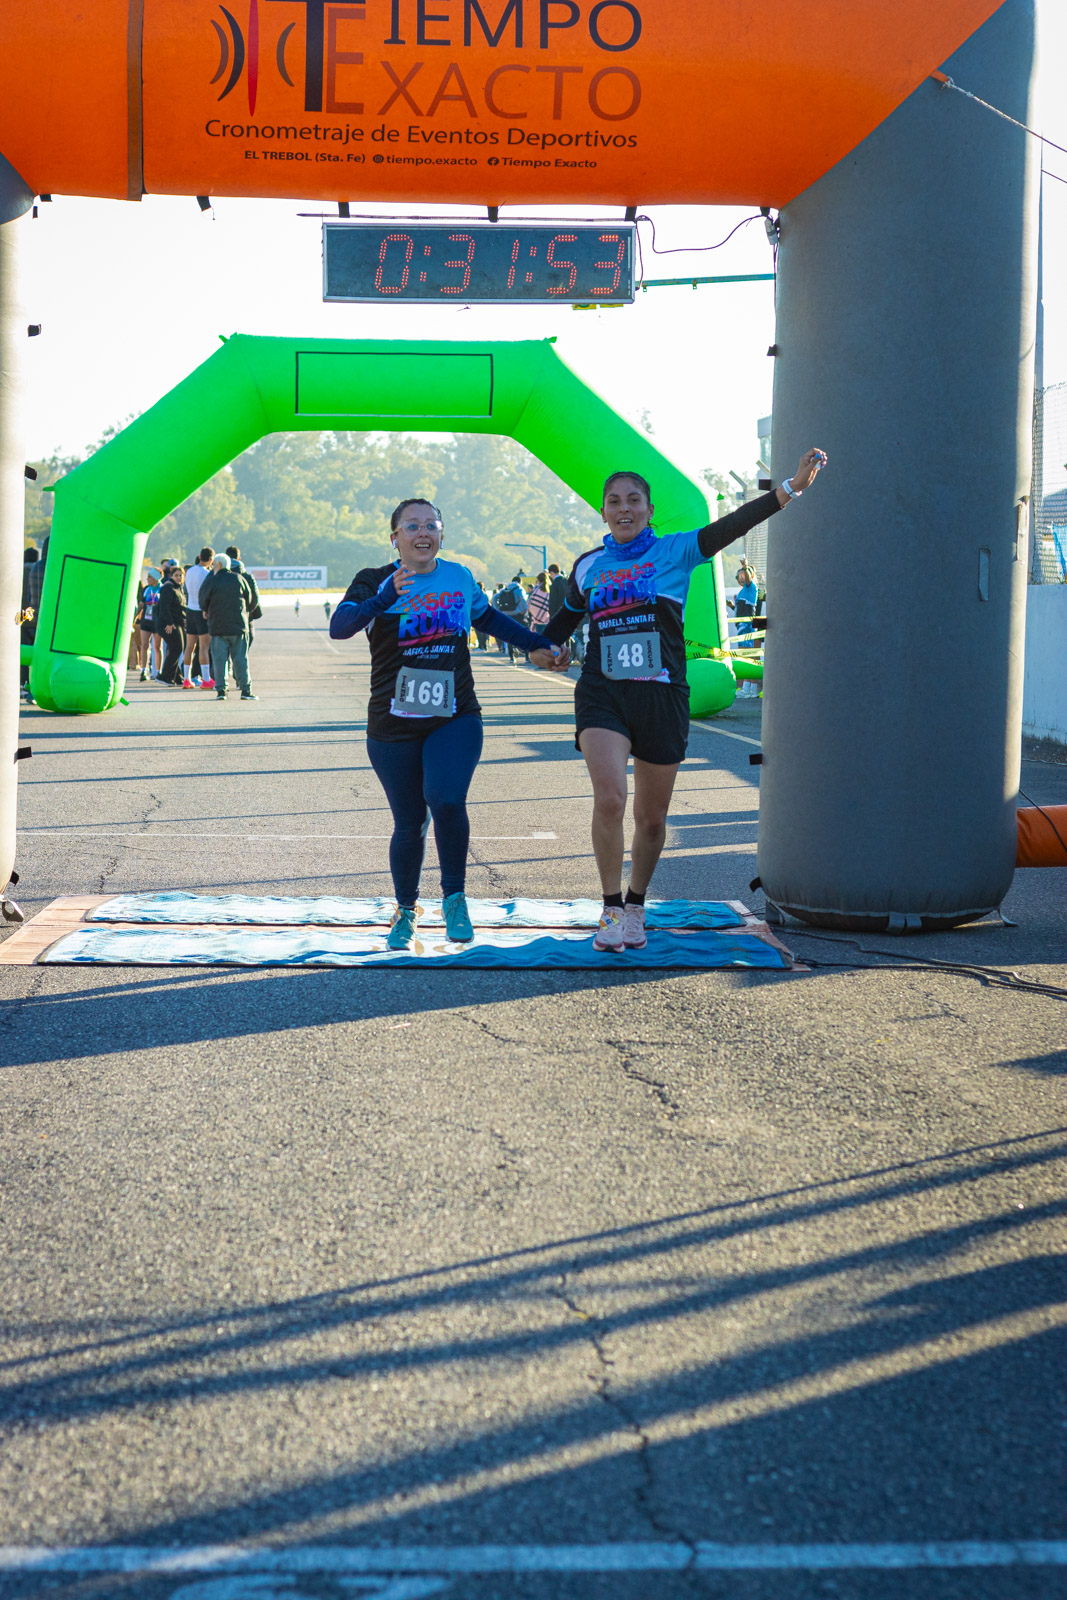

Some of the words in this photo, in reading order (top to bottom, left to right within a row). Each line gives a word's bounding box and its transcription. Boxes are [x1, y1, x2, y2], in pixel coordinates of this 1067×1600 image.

[205, 119, 364, 145] Cronometraje
[371, 124, 400, 142] de
[408, 126, 499, 145] Eventos
[507, 128, 637, 150] Deportivos
[244, 150, 259, 160] EL
[262, 151, 312, 161] TREBOL
[315, 153, 344, 163] (Sta.
[347, 153, 366, 163] Fe)
[386, 155, 477, 166] tiempo.exacto
[502, 157, 551, 169] Tiempo
[554, 159, 598, 168] Exacto
[272, 571, 319, 579] LONG
[626, 614, 647, 625] SANTA
[648, 613, 656, 622] FE
[617, 643, 644, 668] 48
[405, 679, 444, 707] 169
